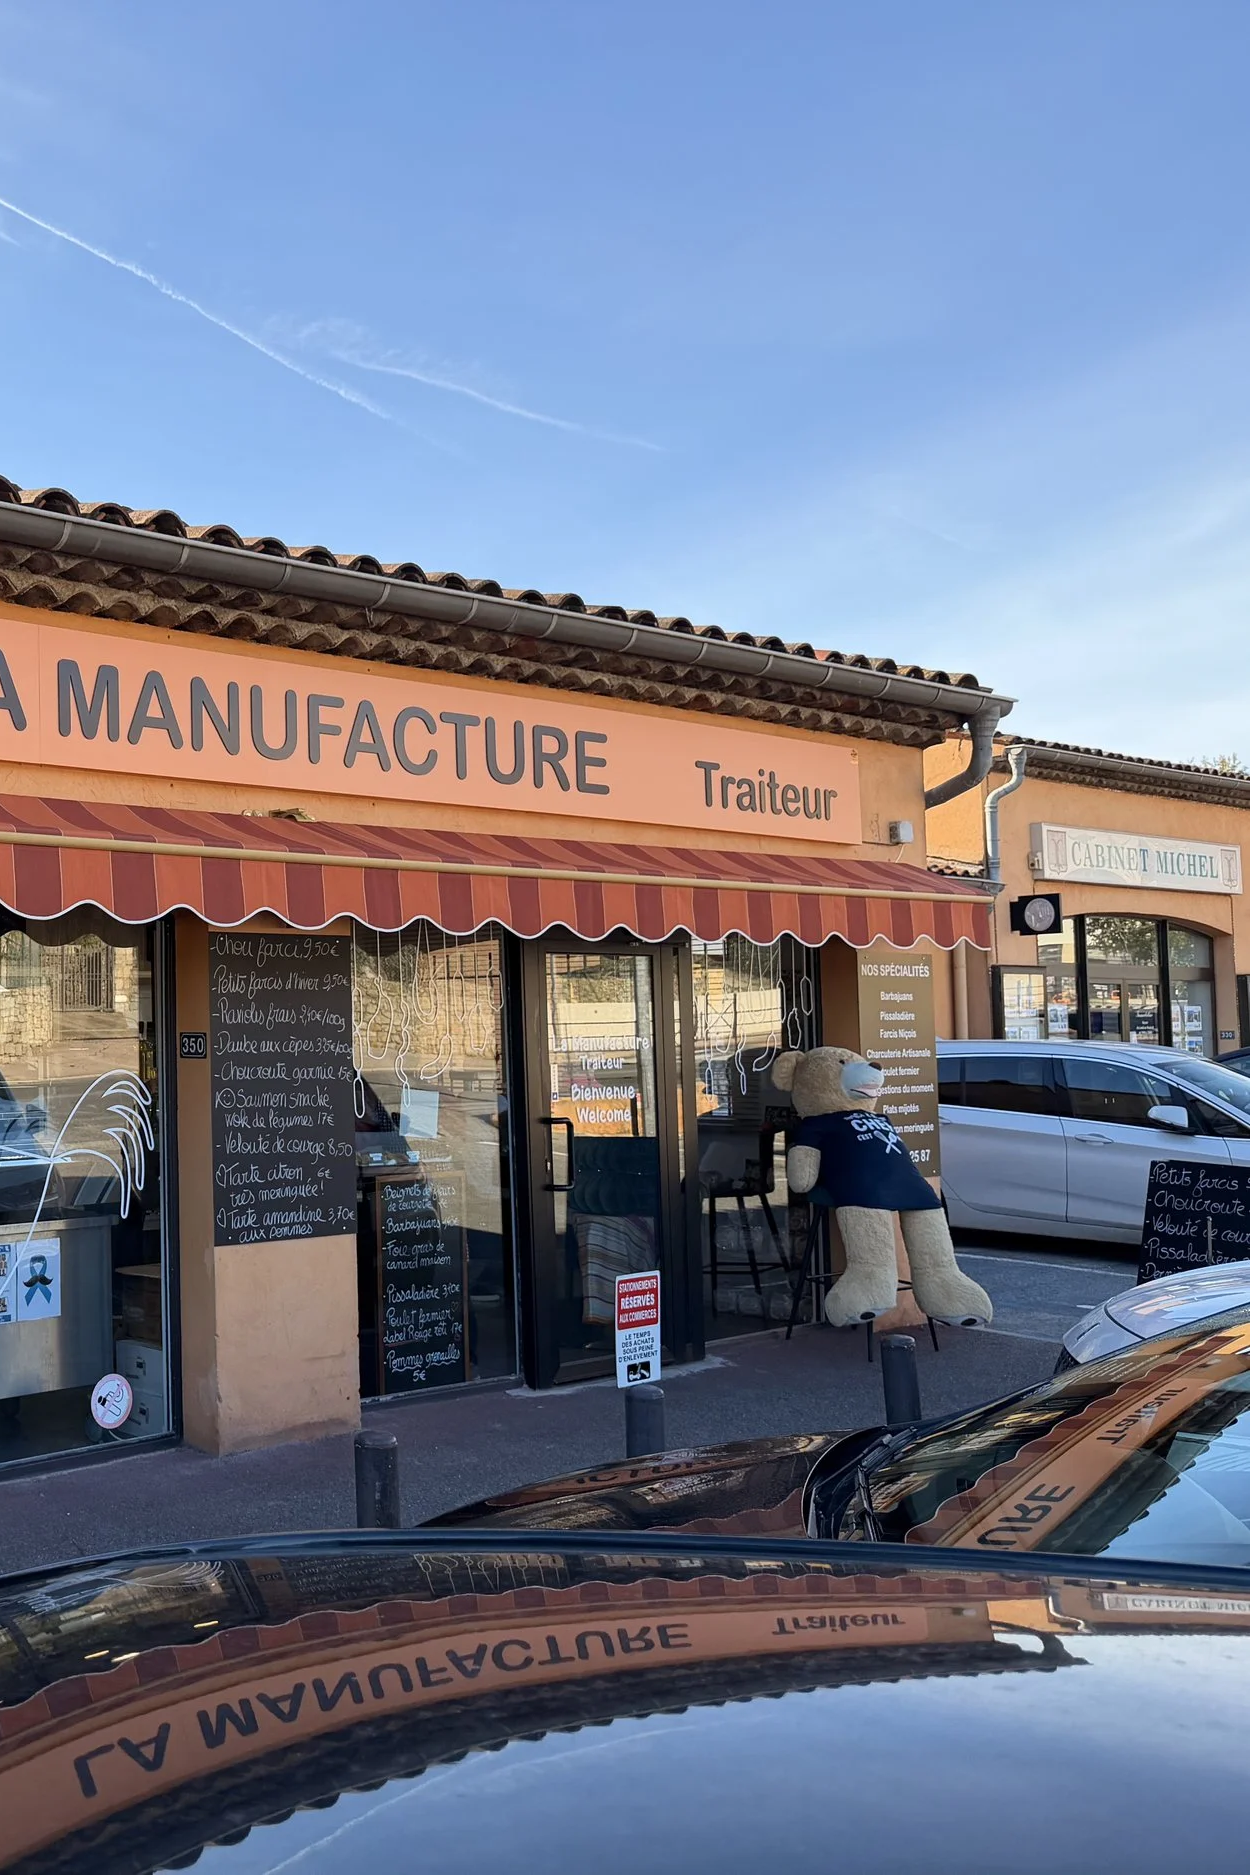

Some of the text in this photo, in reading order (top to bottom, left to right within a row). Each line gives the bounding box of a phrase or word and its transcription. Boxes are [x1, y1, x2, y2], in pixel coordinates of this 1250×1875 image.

[57, 659, 611, 795] MANUFACTURE
[694, 760, 838, 822] Traiteur
[1070, 841, 1219, 879] CABINET MICHEL
[861, 963, 930, 977] NOS SPÉCIALITÉS
[248, 971, 283, 999] farcis
[265, 1002, 297, 1030] frais
[879, 1011, 915, 1021] Pissaladière
[552, 1034, 650, 1051] La Manufacture
[879, 1029, 917, 1040] Farcis Niçois
[1220, 1031, 1234, 1040] 330
[182, 1037, 204, 1053] 350
[259, 1039, 281, 1053] aux
[282, 1036, 313, 1056] cèpes
[579, 1055, 625, 1070] Traiteur
[866, 1049, 931, 1059] Charcuterie Artisanale
[292, 1063, 336, 1086] garnie
[898, 1066, 919, 1076] fermier
[571, 1084, 636, 1101] Bienvenue
[902, 1085, 911, 1094] du
[911, 1083, 934, 1093] moment
[236, 1089, 287, 1107] Saumon
[576, 1107, 632, 1124] Welcome
[882, 1105, 898, 1114] Plats
[252, 1112, 267, 1128] de
[269, 1109, 313, 1133] légumes
[317, 1112, 335, 1126] 17€
[904, 1122, 934, 1134] meringuée
[225, 1133, 270, 1155] Velouté
[271, 1137, 286, 1153] de
[287, 1140, 326, 1164] courge
[920, 1150, 931, 1162] 87
[225, 1162, 266, 1186] Tarte
[317, 1167, 333, 1179] 6€
[1192, 1169, 1239, 1197] farcis
[384, 1184, 421, 1202] Beignets
[422, 1184, 431, 1197] de
[387, 1199, 397, 1212] de
[227, 1205, 356, 1230] Tarte amandine 3,70€
[385, 1217, 441, 1236] Barbajuans
[239, 1229, 267, 1243] aux
[386, 1239, 445, 1260] Foie gras de
[386, 1252, 451, 1270] canard maison
[386, 1283, 441, 1303] Pissaladière
[617, 1279, 657, 1293] STATIONNEMENTS
[620, 1291, 655, 1310] RÉSERVÉS
[386, 1307, 417, 1327] Poulet
[619, 1309, 657, 1323] AUX COMMERCES
[383, 1327, 407, 1343] Label
[408, 1324, 432, 1343] Rouge
[433, 1320, 448, 1337] rôti
[633, 1331, 651, 1340] TEMPS
[621, 1337, 654, 1349] DES ACHATS
[622, 1344, 654, 1355] SOUS PEINE
[386, 1343, 461, 1369] Pommes grenailles
[618, 1350, 658, 1363] D'ENLEVEMENT
[412, 1370, 427, 1382] 5€
